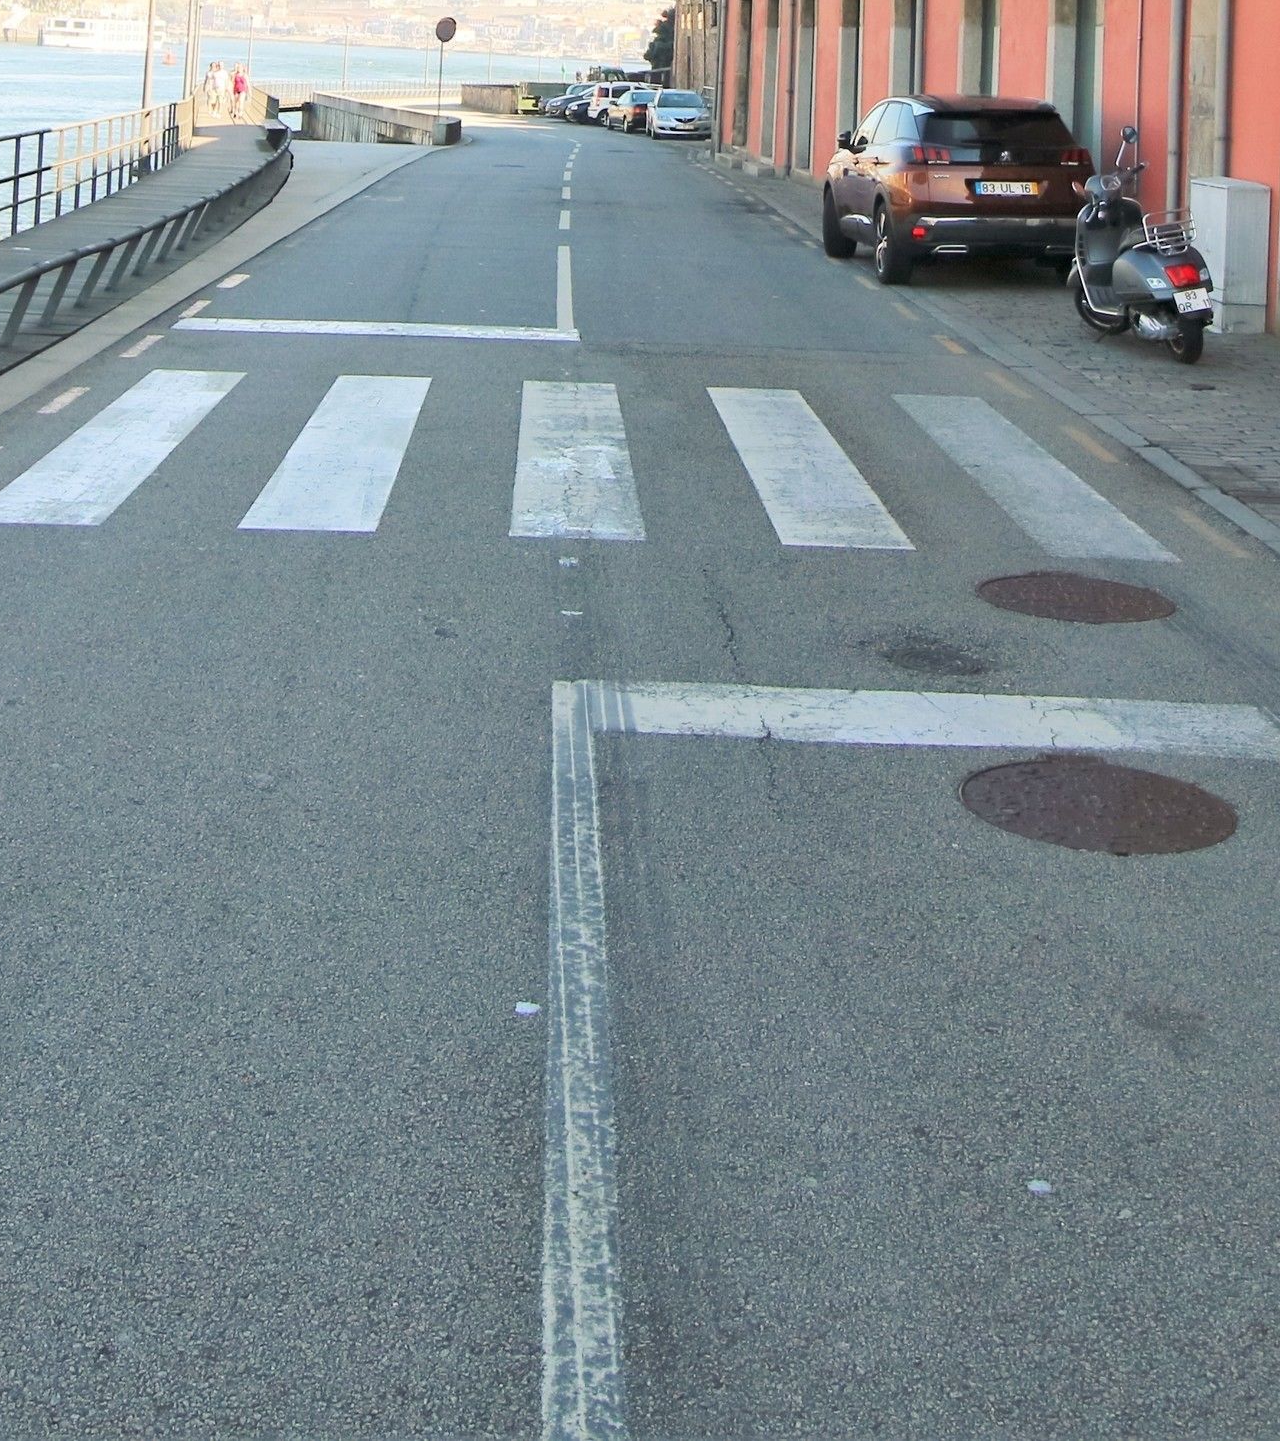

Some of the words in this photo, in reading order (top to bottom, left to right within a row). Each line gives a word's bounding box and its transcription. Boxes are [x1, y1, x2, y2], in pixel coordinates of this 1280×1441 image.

[982, 183, 995, 193] 83
[1000, 184, 1015, 193] UL
[1021, 183, 1031, 193] 16
[1185, 291, 1197, 300] 83
